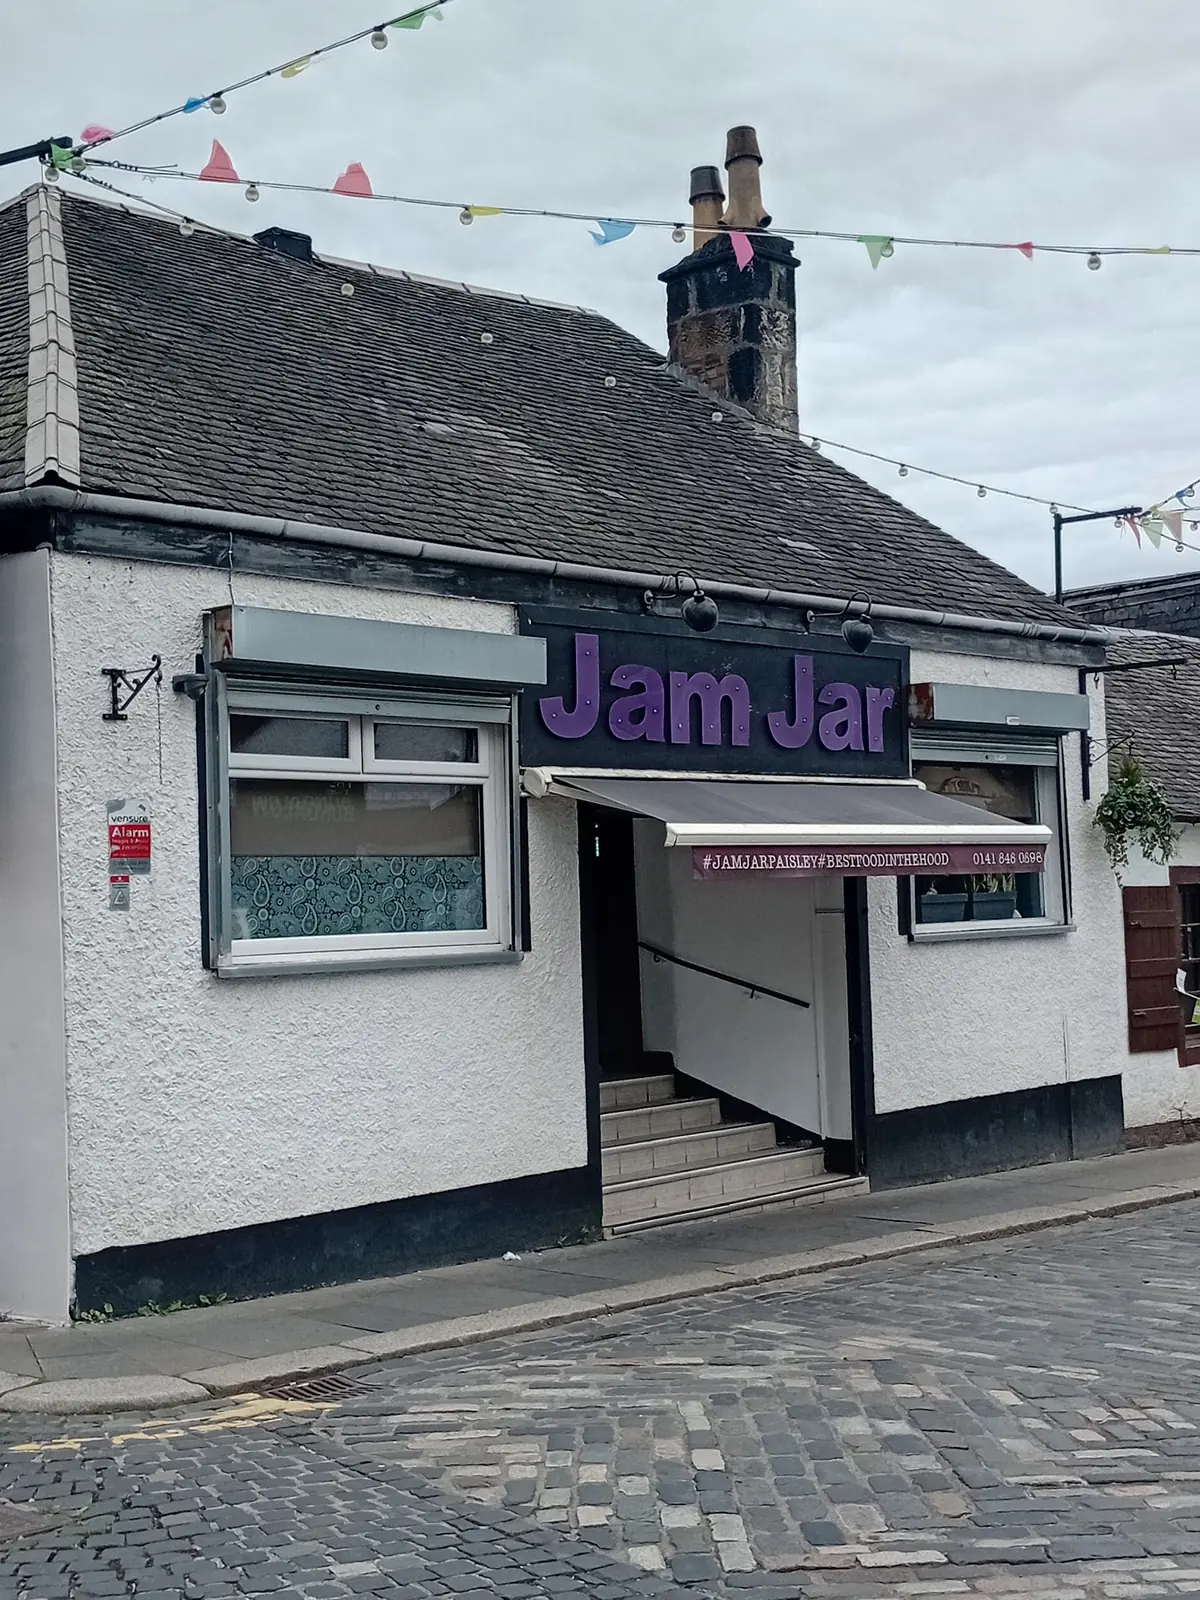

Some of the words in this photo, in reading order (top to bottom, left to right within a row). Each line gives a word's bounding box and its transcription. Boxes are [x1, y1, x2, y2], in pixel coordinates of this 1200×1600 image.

[539, 632, 750, 747] Jam
[767, 654, 896, 753] Jar
[112, 826, 149, 838] Alarm
[973, 852, 996, 865] 0141
[999, 851, 1015, 865] 846
